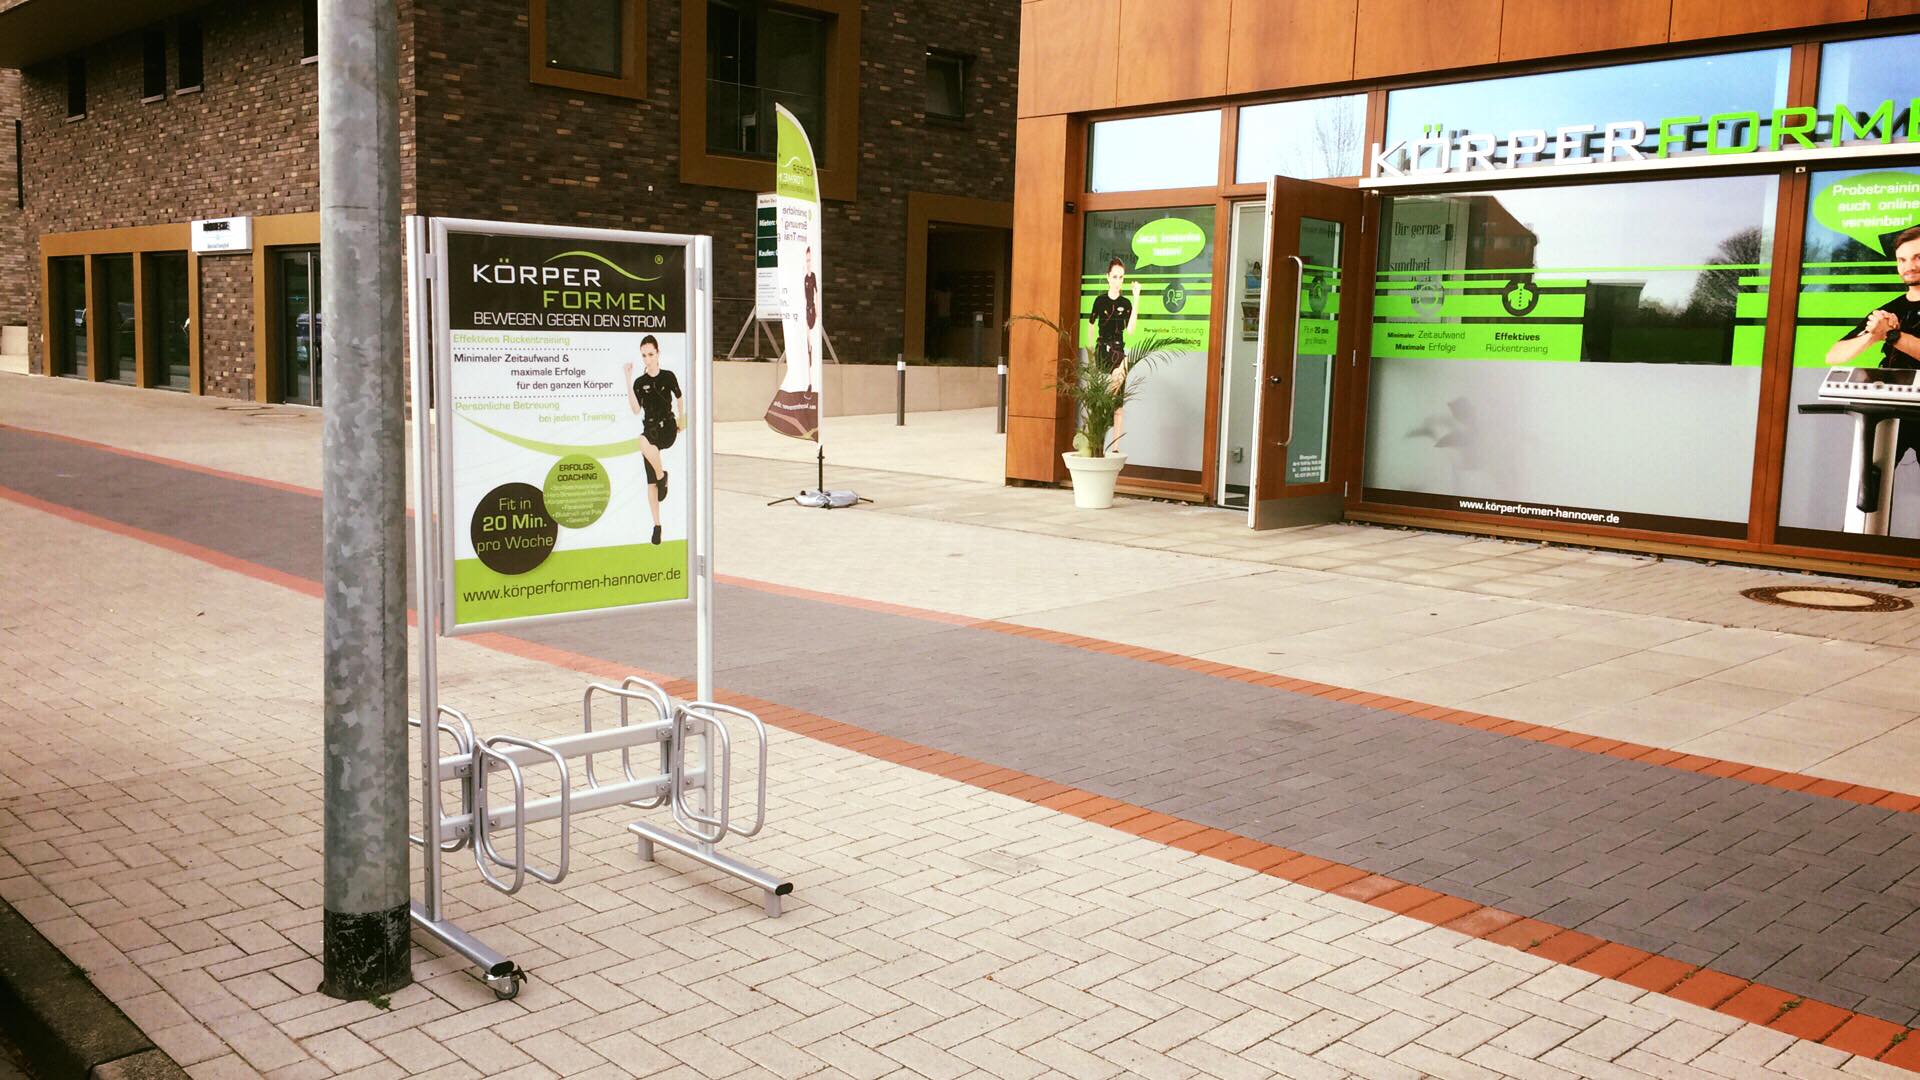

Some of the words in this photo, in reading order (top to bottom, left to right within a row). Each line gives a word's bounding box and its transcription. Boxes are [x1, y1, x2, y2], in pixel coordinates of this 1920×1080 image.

[1838, 199, 1871, 212] auch
[1879, 197, 1920, 211] online
[1394, 221, 1409, 236] Dir
[1410, 223, 1441, 240] gerne:
[473, 257, 602, 288] KÖRPER
[543, 290, 666, 311] FORMEN
[474, 311, 543, 326] BEWEGEN
[547, 313, 590, 327] GEGEN
[594, 314, 621, 328] DEN
[623, 315, 667, 328] STROM
[453, 333, 500, 344] Effektives
[1418, 330, 1466, 340] Zeitaufwand
[1495, 332, 1541, 341] Effektives
[1428, 342, 1457, 354] Erfolge
[454, 353, 501, 363] Minimaler
[505, 353, 560, 363] Zeitaufwand
[562, 354, 569, 363] &
[511, 367, 552, 377] maximale
[554, 367, 586, 378] Erfolge
[533, 381, 548, 390] den
[550, 383, 581, 391] ganzen
[513, 401, 560, 411] Betreuung
[582, 412, 616, 423] Training
[557, 472, 598, 482] COACHING
[499, 497, 516, 511] Fit
[520, 497, 531, 510] in
[1459, 499, 1620, 524] www.körperformen-hannover.de
[483, 515, 507, 532] 20
[512, 513, 547, 530] Min.
[477, 539, 501, 555] pro
[504, 534, 554, 551] Woche
[463, 567, 681, 603] www.körperformen-hannover.de
